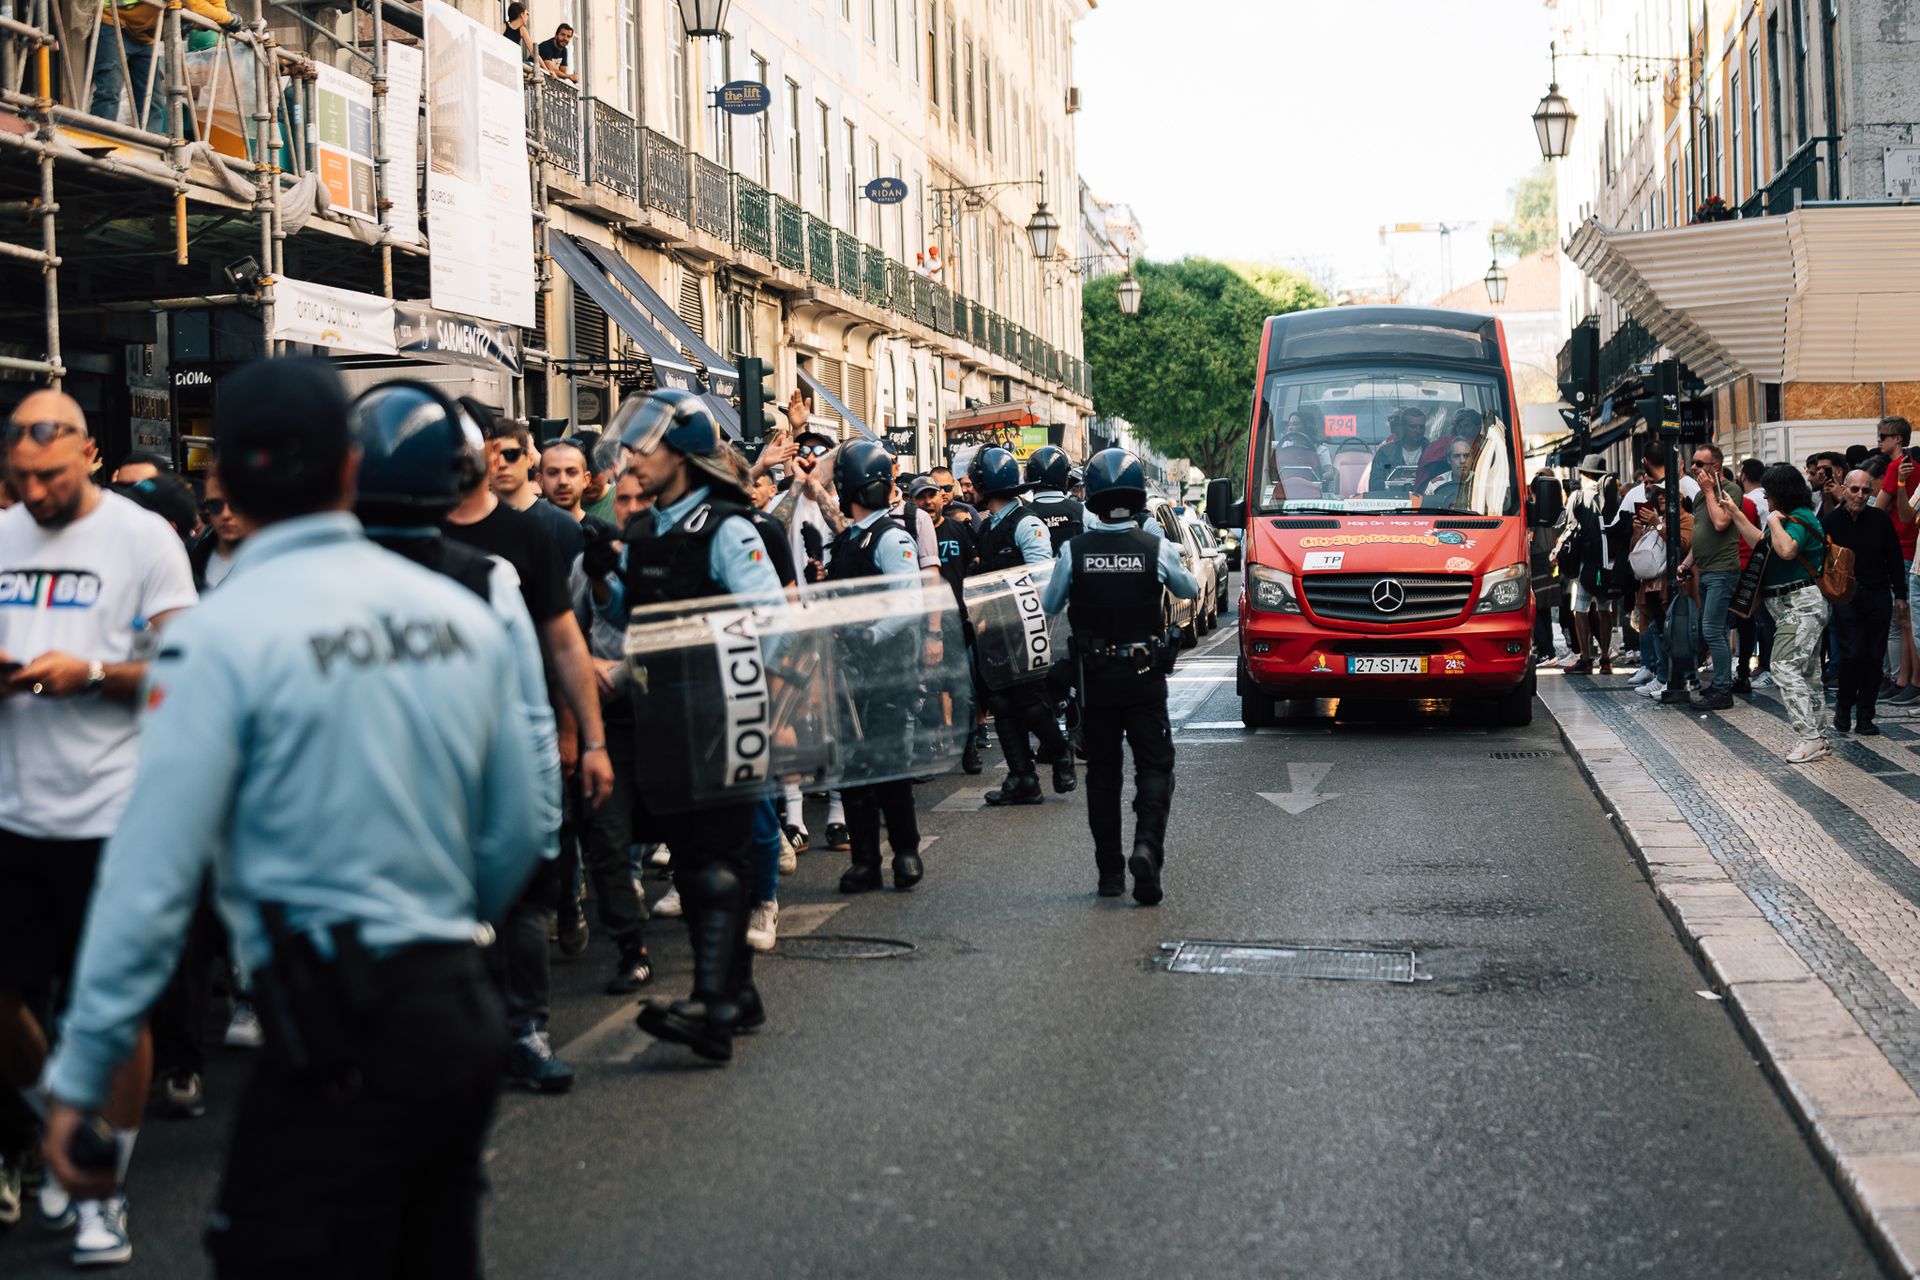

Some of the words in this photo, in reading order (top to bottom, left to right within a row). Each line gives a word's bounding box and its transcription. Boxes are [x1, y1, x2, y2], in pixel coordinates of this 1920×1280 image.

[724, 91, 743, 101] the
[744, 87, 762, 98] lift
[871, 189, 902, 198] RIDAN
[436, 319, 491, 359] SARMENTO
[1327, 418, 1354, 432] 794
[939, 540, 960, 556] 75
[1086, 554, 1143, 568] POLÍCIA
[1323, 556, 1342, 564] TP
[1015, 575, 1049, 669] POLÍCIA
[309, 614, 477, 677] POLÍCIA
[724, 616, 767, 783] POLÍCIA
